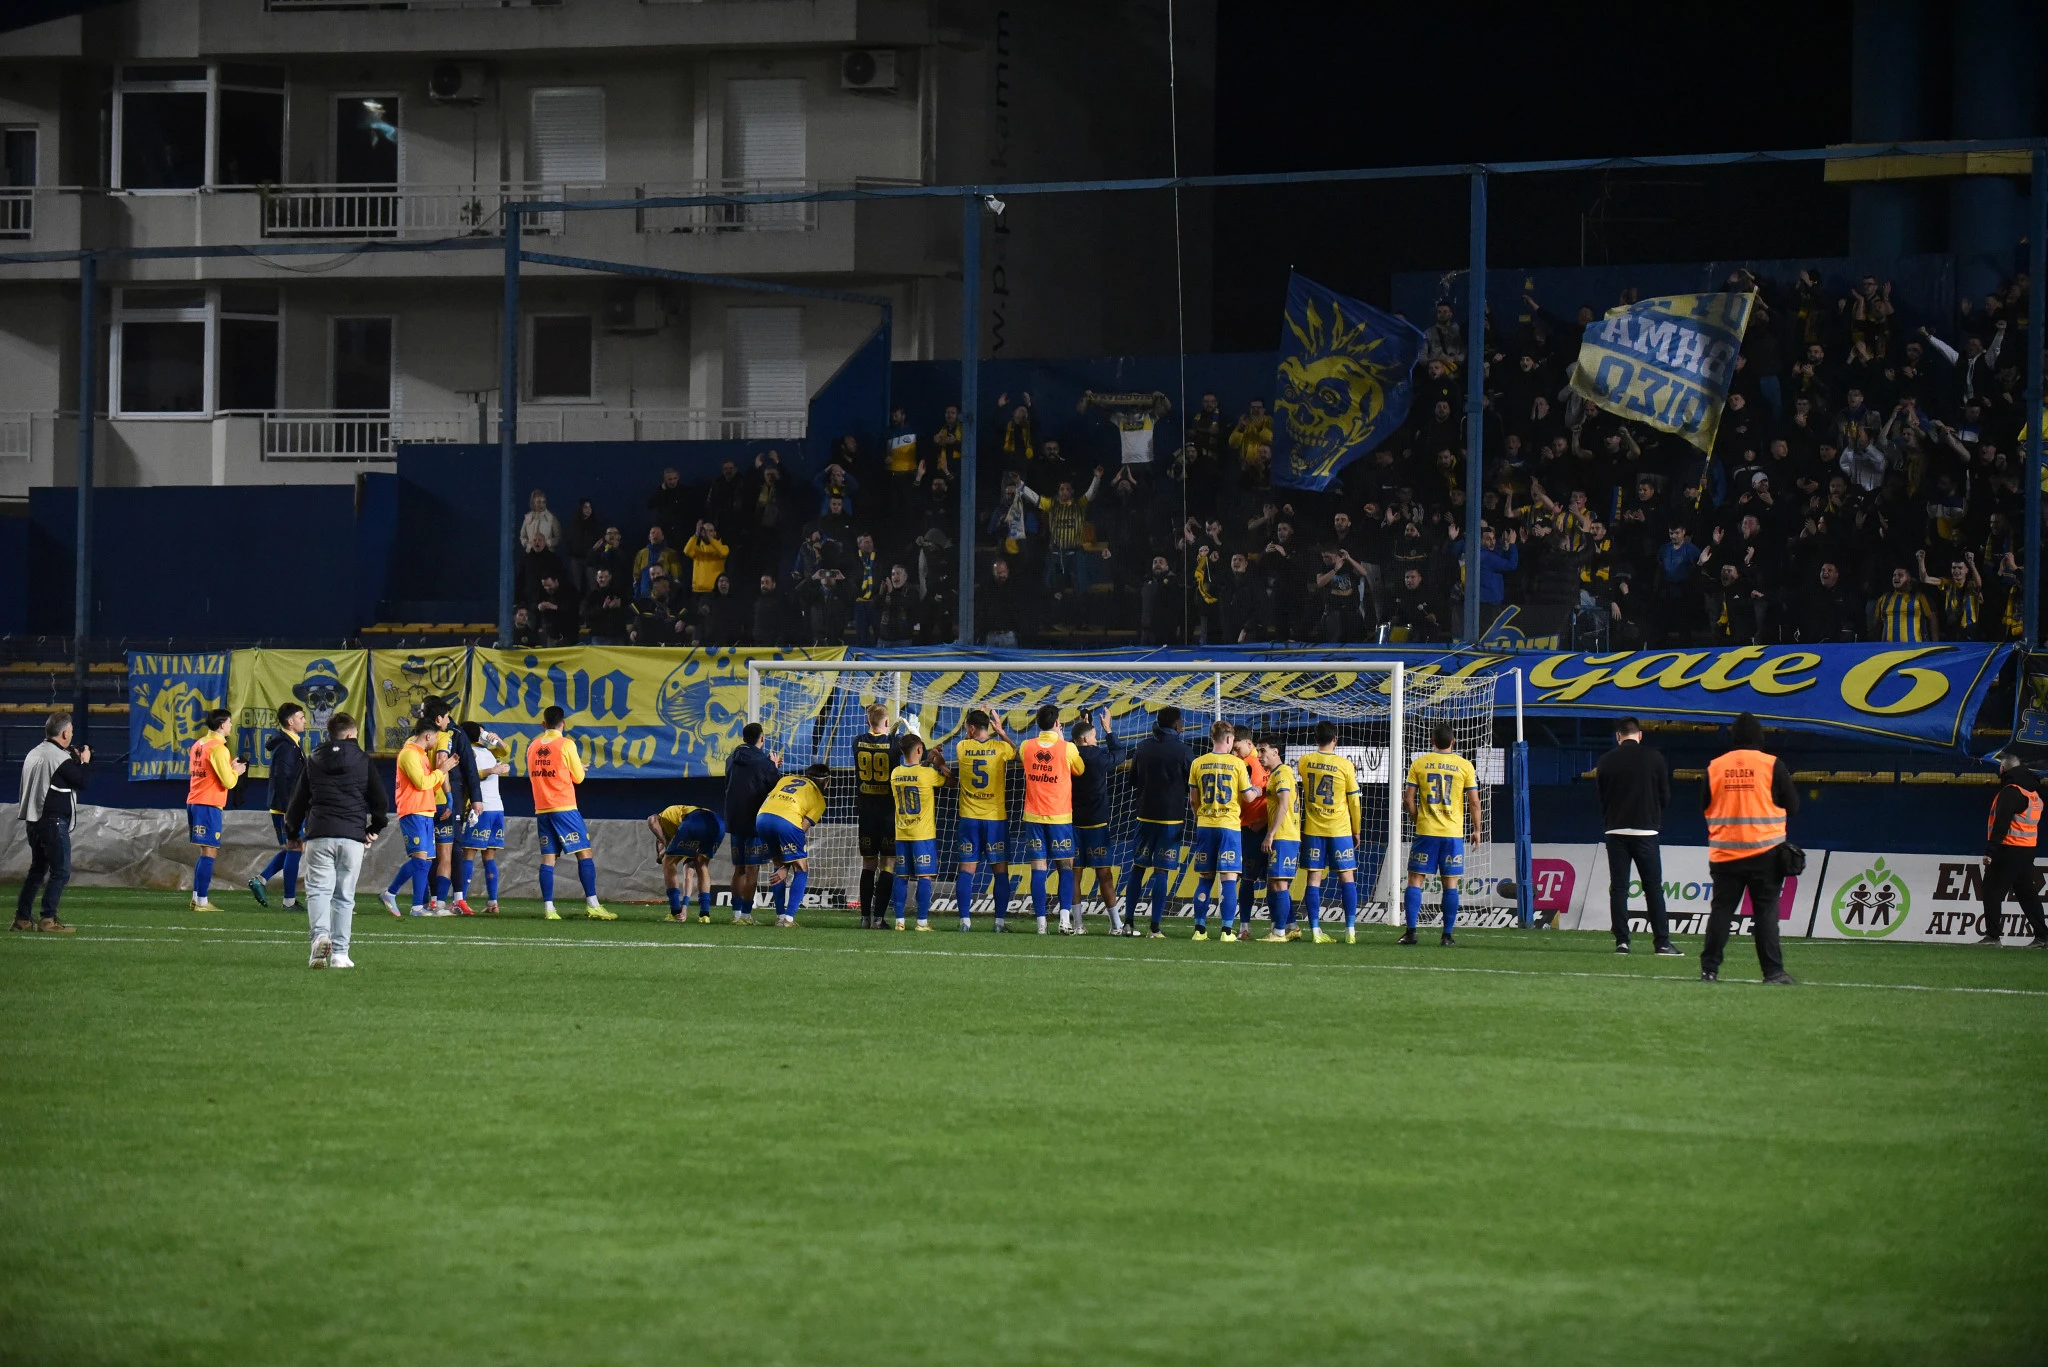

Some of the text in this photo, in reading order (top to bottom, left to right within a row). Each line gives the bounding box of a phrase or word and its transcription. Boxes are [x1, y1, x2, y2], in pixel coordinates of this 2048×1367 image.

[132, 655, 226, 675] ANTINAZI
[1529, 646, 1822, 702] Gate
[1840, 645, 1958, 716] 6
[858, 751, 890, 782] 99
[965, 749, 996, 757] MLADEN
[1032, 763, 1053, 772] errea
[780, 779, 807, 794] 2
[972, 760, 989, 789] 5
[1028, 774, 1059, 784] novibet
[1725, 769, 1754, 778] GOLDEN
[896, 786, 921, 815] 10
[1201, 774, 1232, 805] 65
[1308, 773, 1334, 805] 14
[1427, 773, 1453, 806] 31
[1052, 839, 1072, 848] A4B
[1537, 871, 1564, 901] T
